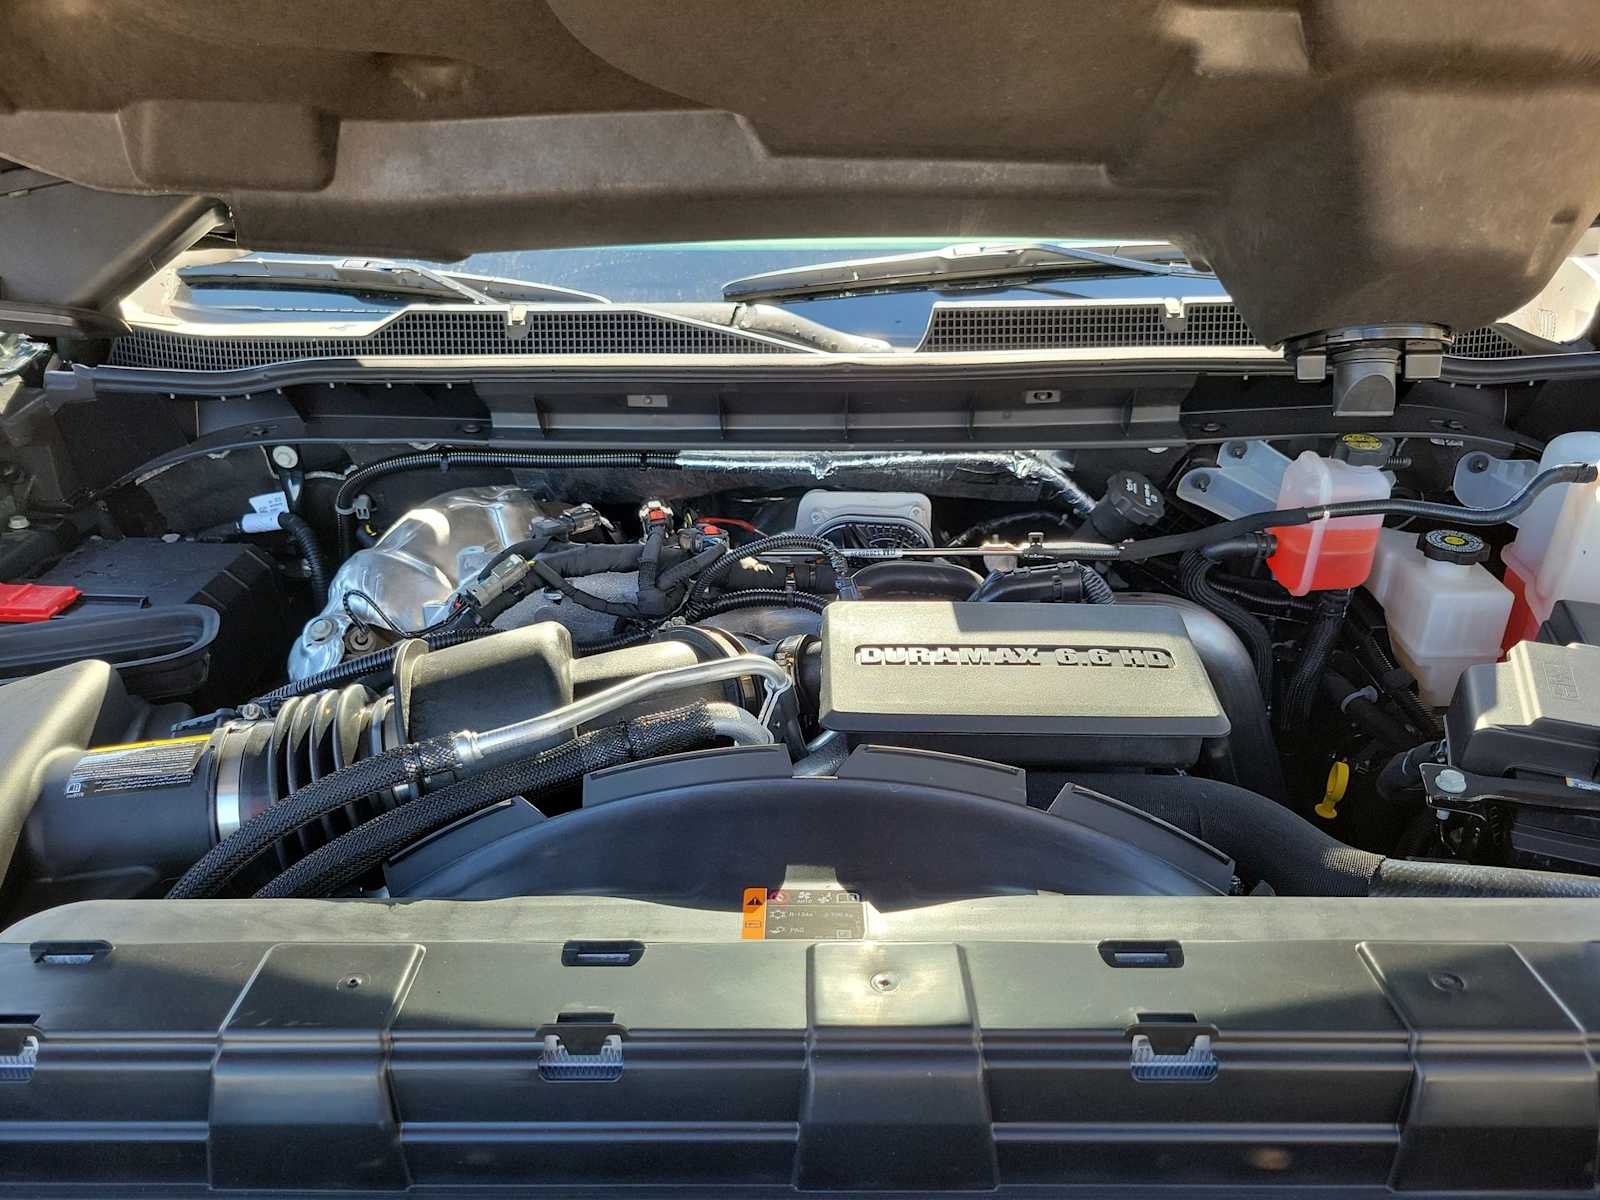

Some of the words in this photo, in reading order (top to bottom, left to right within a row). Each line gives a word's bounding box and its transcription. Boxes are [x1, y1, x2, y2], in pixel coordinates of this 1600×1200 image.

[858, 647, 1041, 666] DURAMAX
[1054, 647, 1113, 667] 6.6
[1119, 648, 1172, 668] HD
